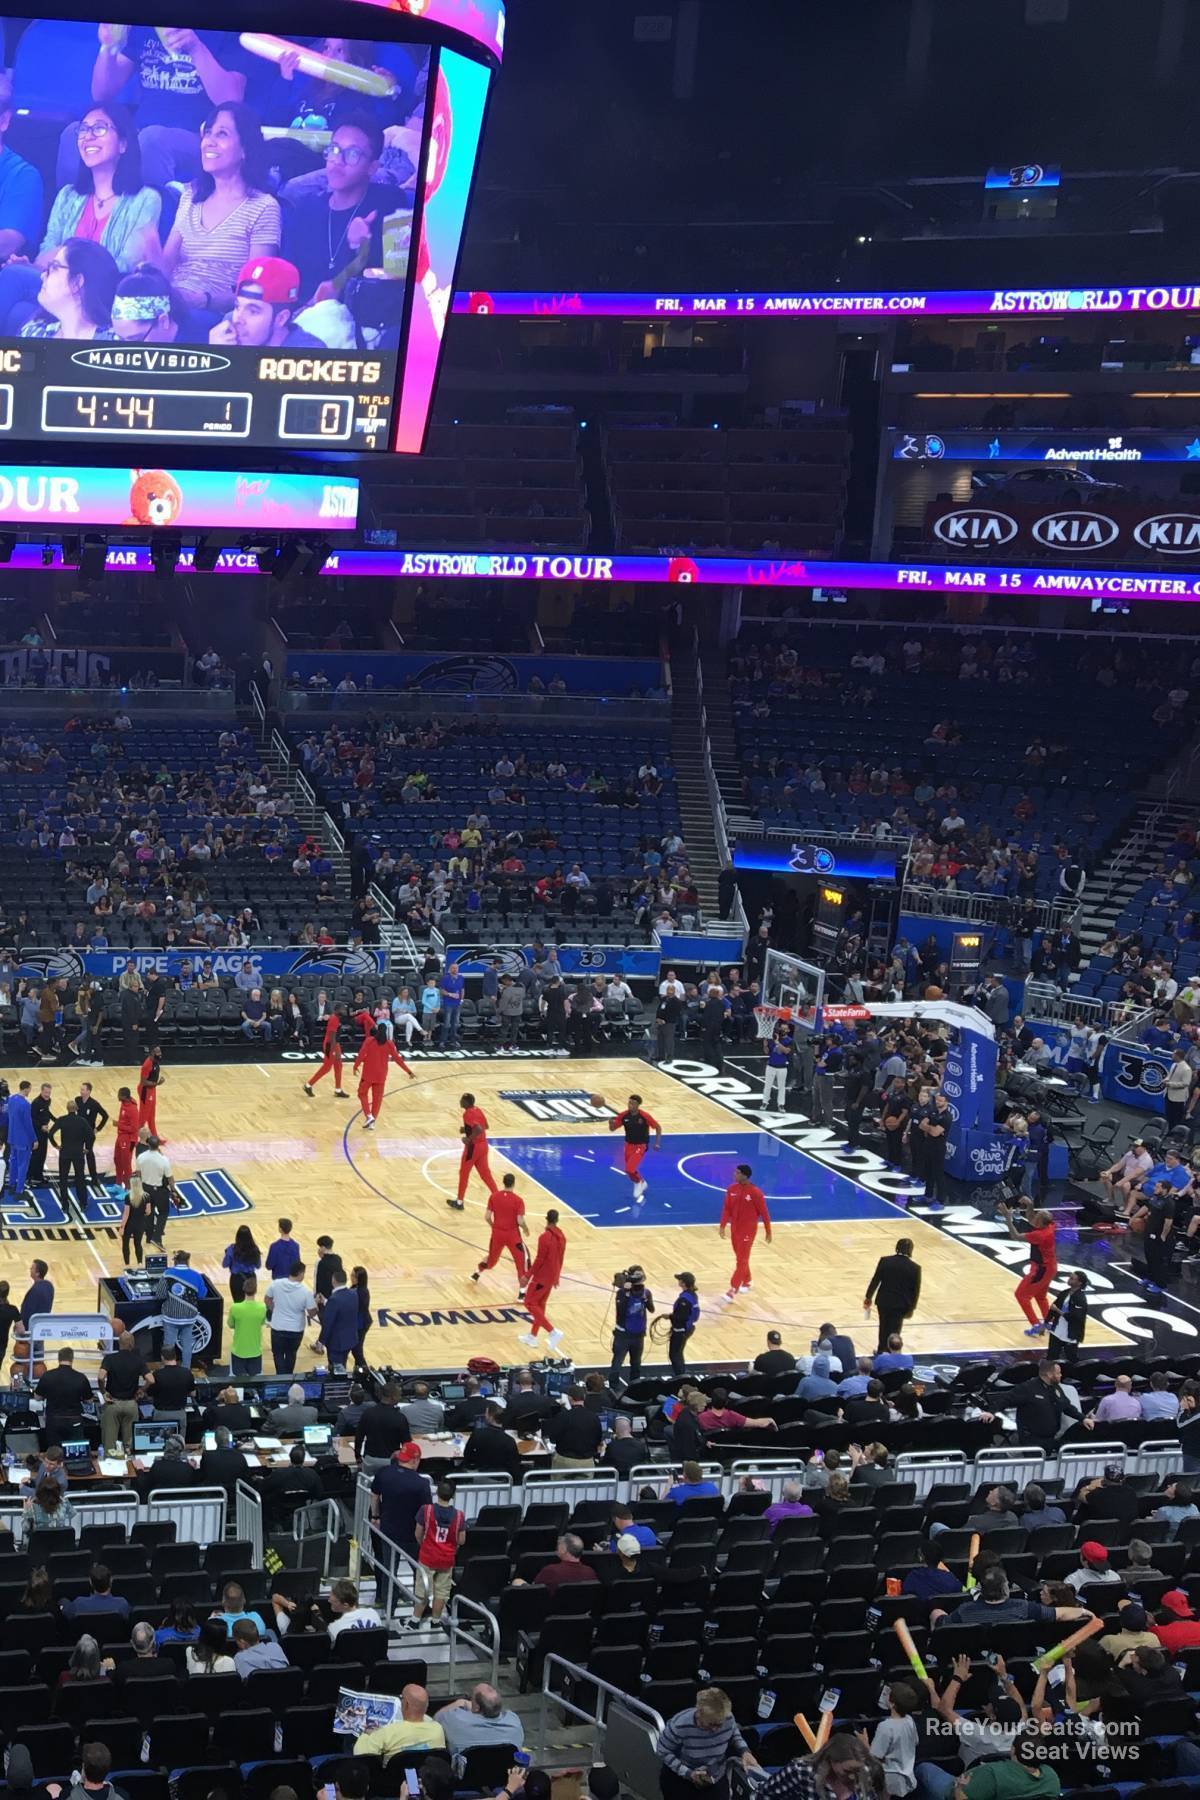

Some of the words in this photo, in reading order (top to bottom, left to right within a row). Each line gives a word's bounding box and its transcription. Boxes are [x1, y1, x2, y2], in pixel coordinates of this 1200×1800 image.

[655, 297, 684, 312] FRI,
[693, 298, 726, 311] MAR
[736, 298, 755, 311] 15
[763, 296, 927, 311] AMWAYCENTER.COM
[259, 357, 381, 382] ROCKETS
[358, 395, 371, 404] TM
[372, 396, 390, 405] FLS
[77, 395, 154, 428] 4:44
[224, 401, 231, 421] 1
[321, 403, 340, 433] 0
[367, 404, 377, 418] 0
[1044, 448, 1141, 461] AdventHealth
[947, 517, 1003, 540] KIA
[1046, 519, 1103, 543] KIA
[532, 556, 613, 579] TOUR
[897, 570, 933, 587] FRI,
[944, 571, 986, 587] MAR
[999, 573, 1022, 588] 15
[580, 950, 606, 968] 30
[970, 1042, 979, 1093] AdventHealth
[1114, 1051, 1170, 1096] 30
[657, 1058, 927, 1197] ORLANDO
[971, 1149, 1001, 1162] Olive
[974, 1160, 1006, 1176] Gard
[0, 1227, 124, 1241] LANDO
[907, 1204, 1199, 1338] MAGIC
[436, 1525, 449, 1543] 13
